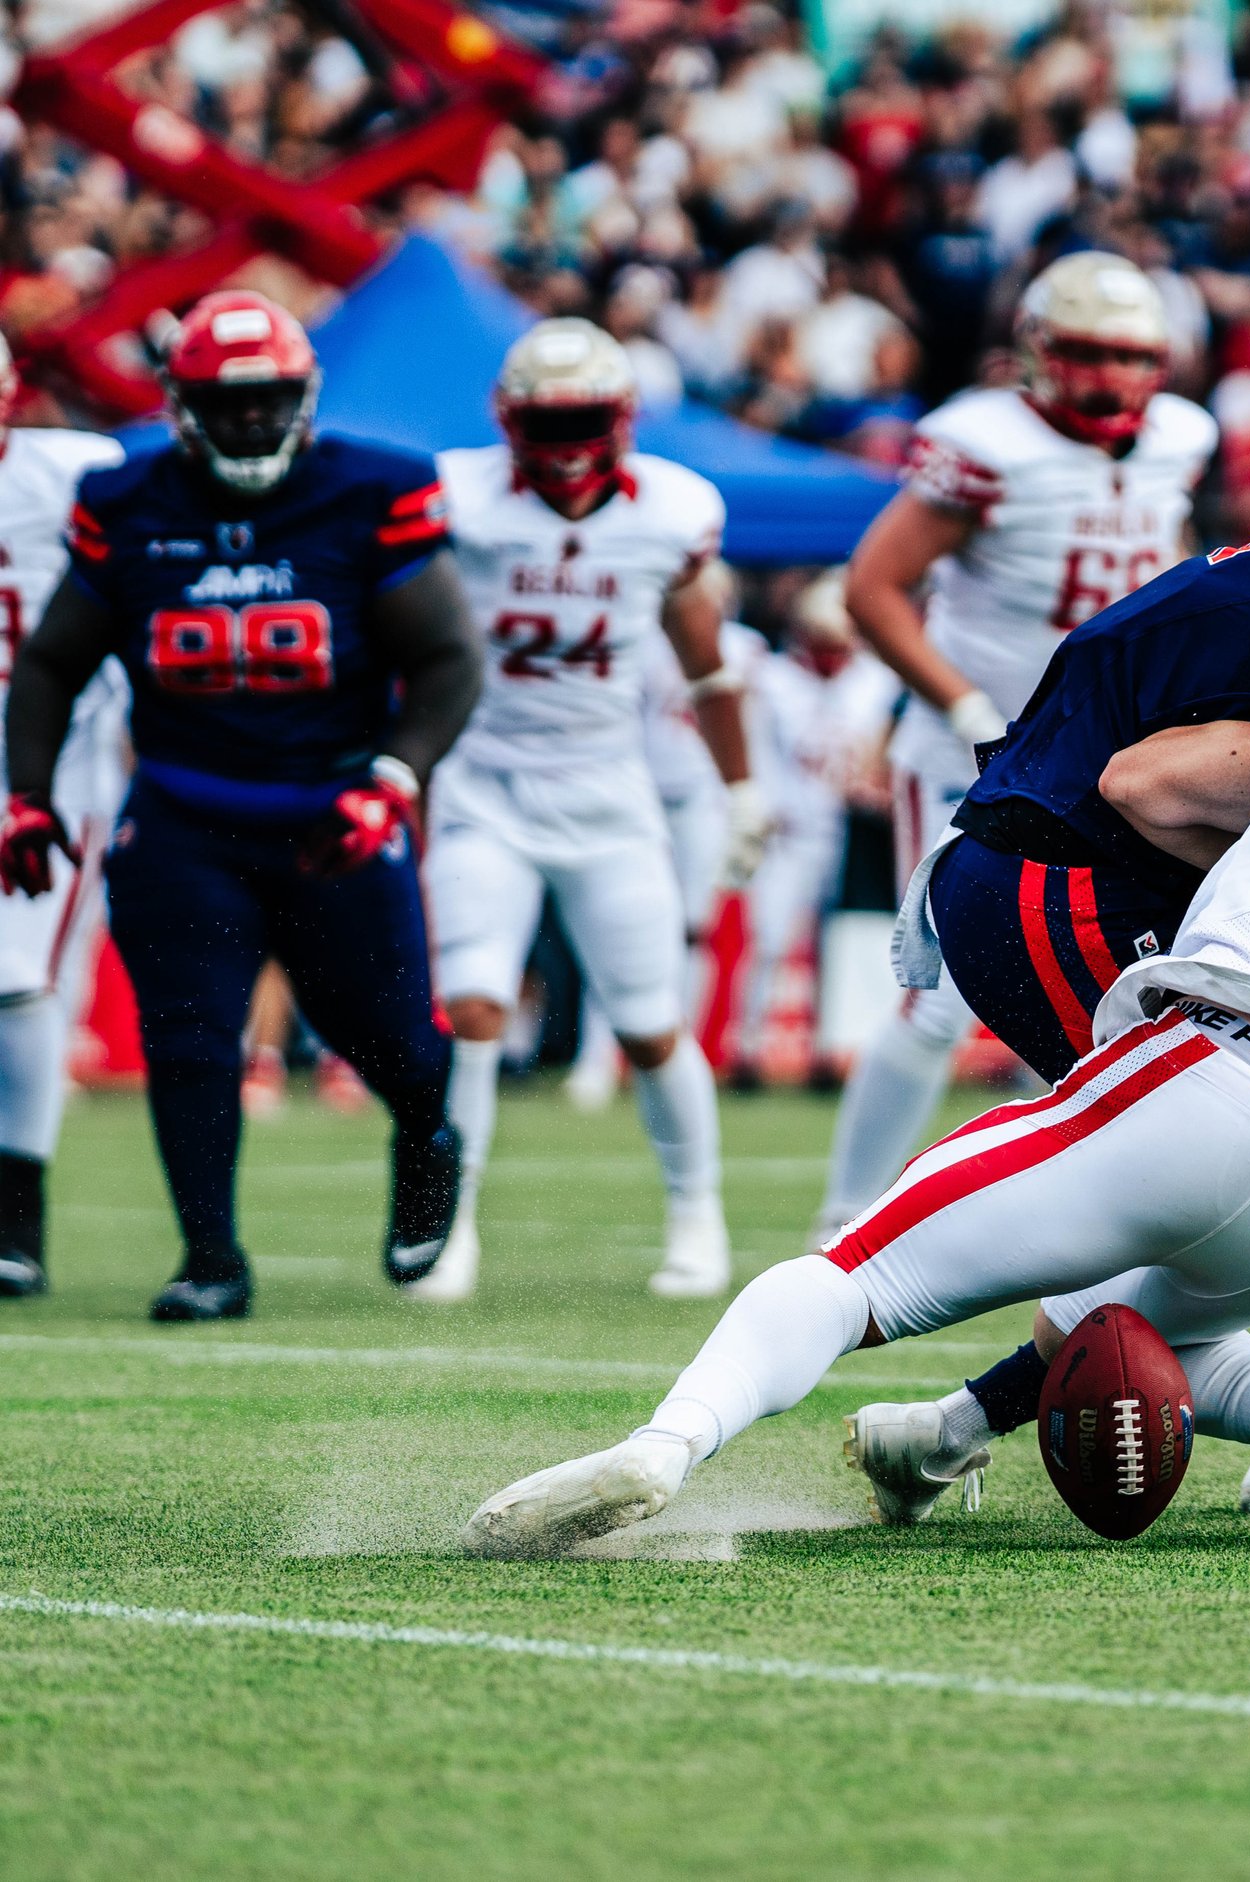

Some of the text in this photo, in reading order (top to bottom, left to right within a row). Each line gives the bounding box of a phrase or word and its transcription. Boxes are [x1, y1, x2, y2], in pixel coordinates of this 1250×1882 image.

[492, 609, 613, 680] 24
[1078, 1407, 1099, 1485] Wilson
[1158, 1402, 1176, 1484] Wilson
